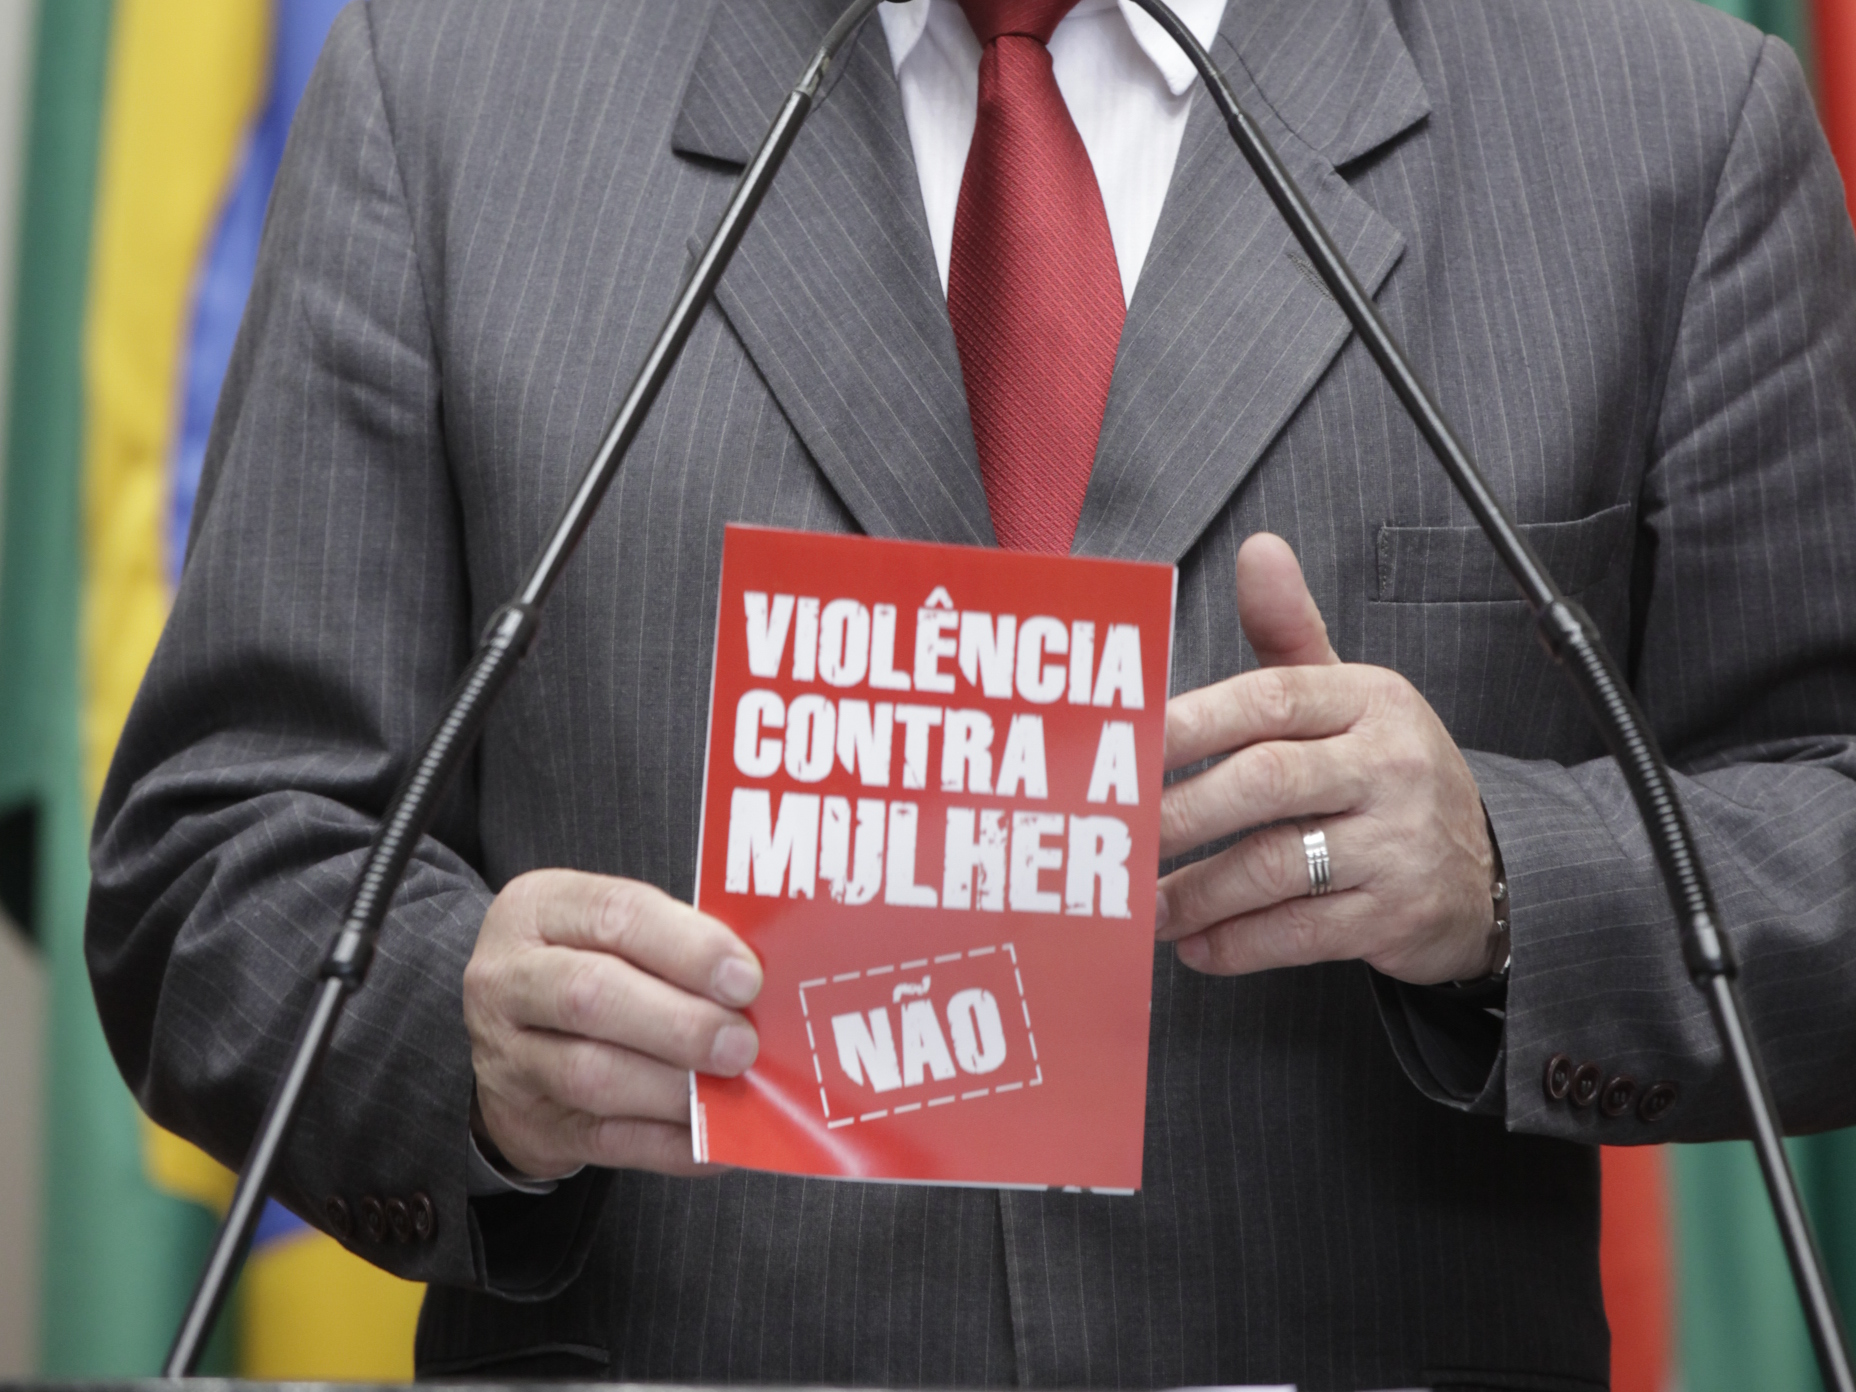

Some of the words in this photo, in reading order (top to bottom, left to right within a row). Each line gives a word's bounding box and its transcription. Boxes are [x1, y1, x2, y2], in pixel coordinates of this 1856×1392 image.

[744, 586, 1145, 709] VIOLÊNCIA
[733, 689, 1048, 799] CONTRA
[1086, 721, 1140, 805] A
[725, 788, 1132, 918] MULHER
[831, 976, 1007, 1093] NÃO
